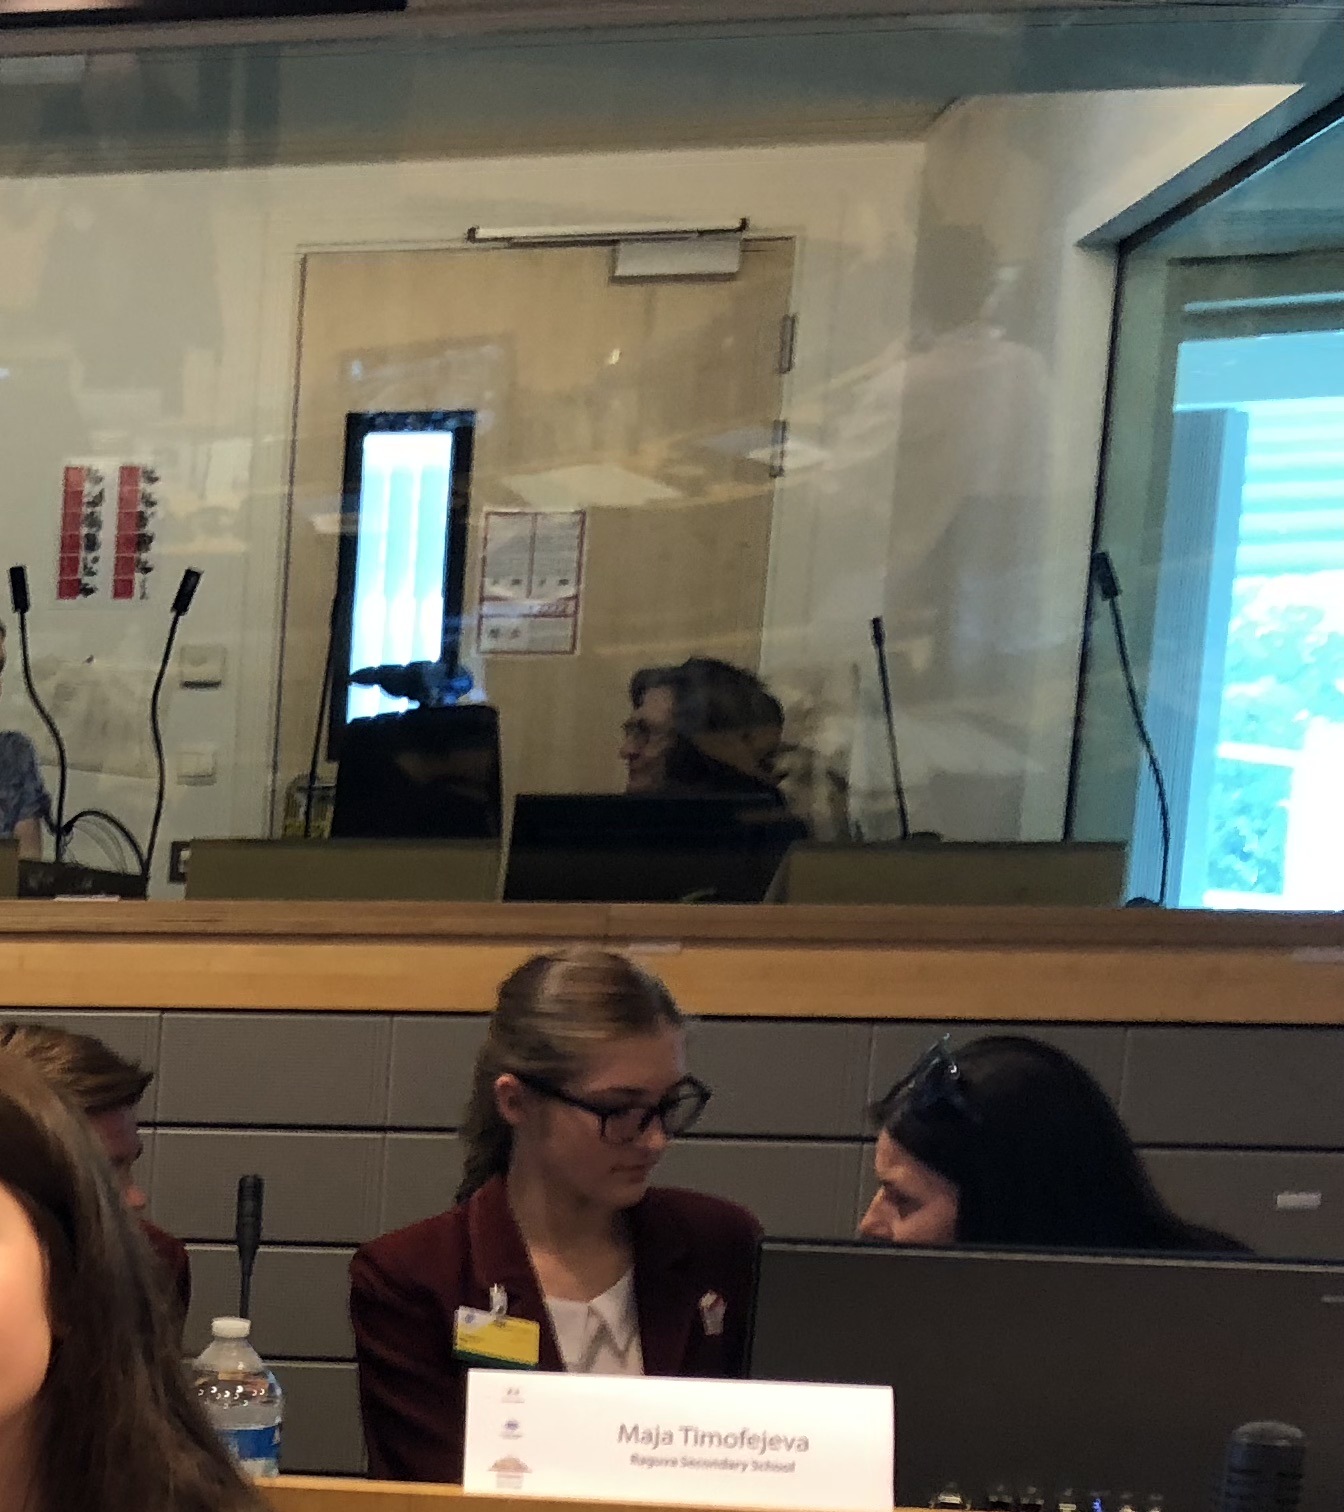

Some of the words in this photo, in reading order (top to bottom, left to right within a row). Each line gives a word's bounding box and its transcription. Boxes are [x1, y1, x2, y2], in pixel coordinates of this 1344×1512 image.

[618, 1423, 674, 1450] Maja
[679, 1425, 810, 1456] Timofejeva
[680, 1455, 749, 1474] Secondary
[751, 1460, 796, 1474] School
